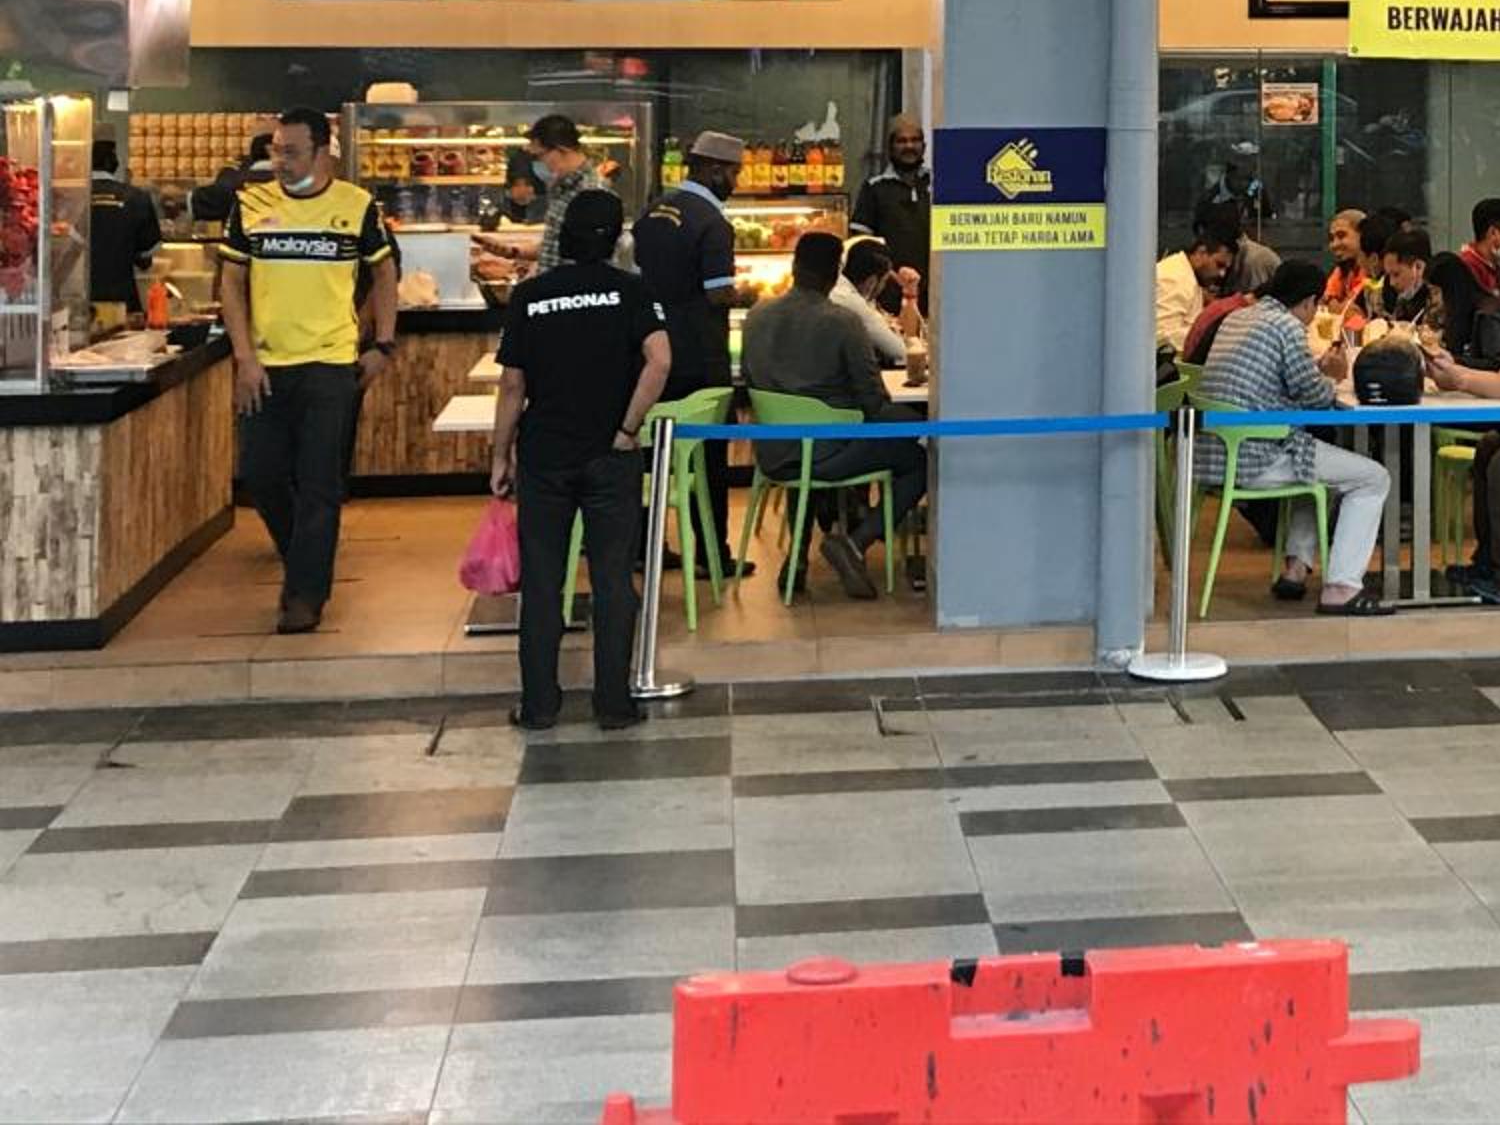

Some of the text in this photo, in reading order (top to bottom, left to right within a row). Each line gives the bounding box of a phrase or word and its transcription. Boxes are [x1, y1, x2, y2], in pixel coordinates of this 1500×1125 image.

[950, 212, 1086, 225] BERWAJAH BARU NAMUN
[942, 230, 1094, 244] HARGA TETAP HARGA LAMA
[262, 237, 337, 253] Malaysia
[527, 291, 620, 317] PETRONAS
